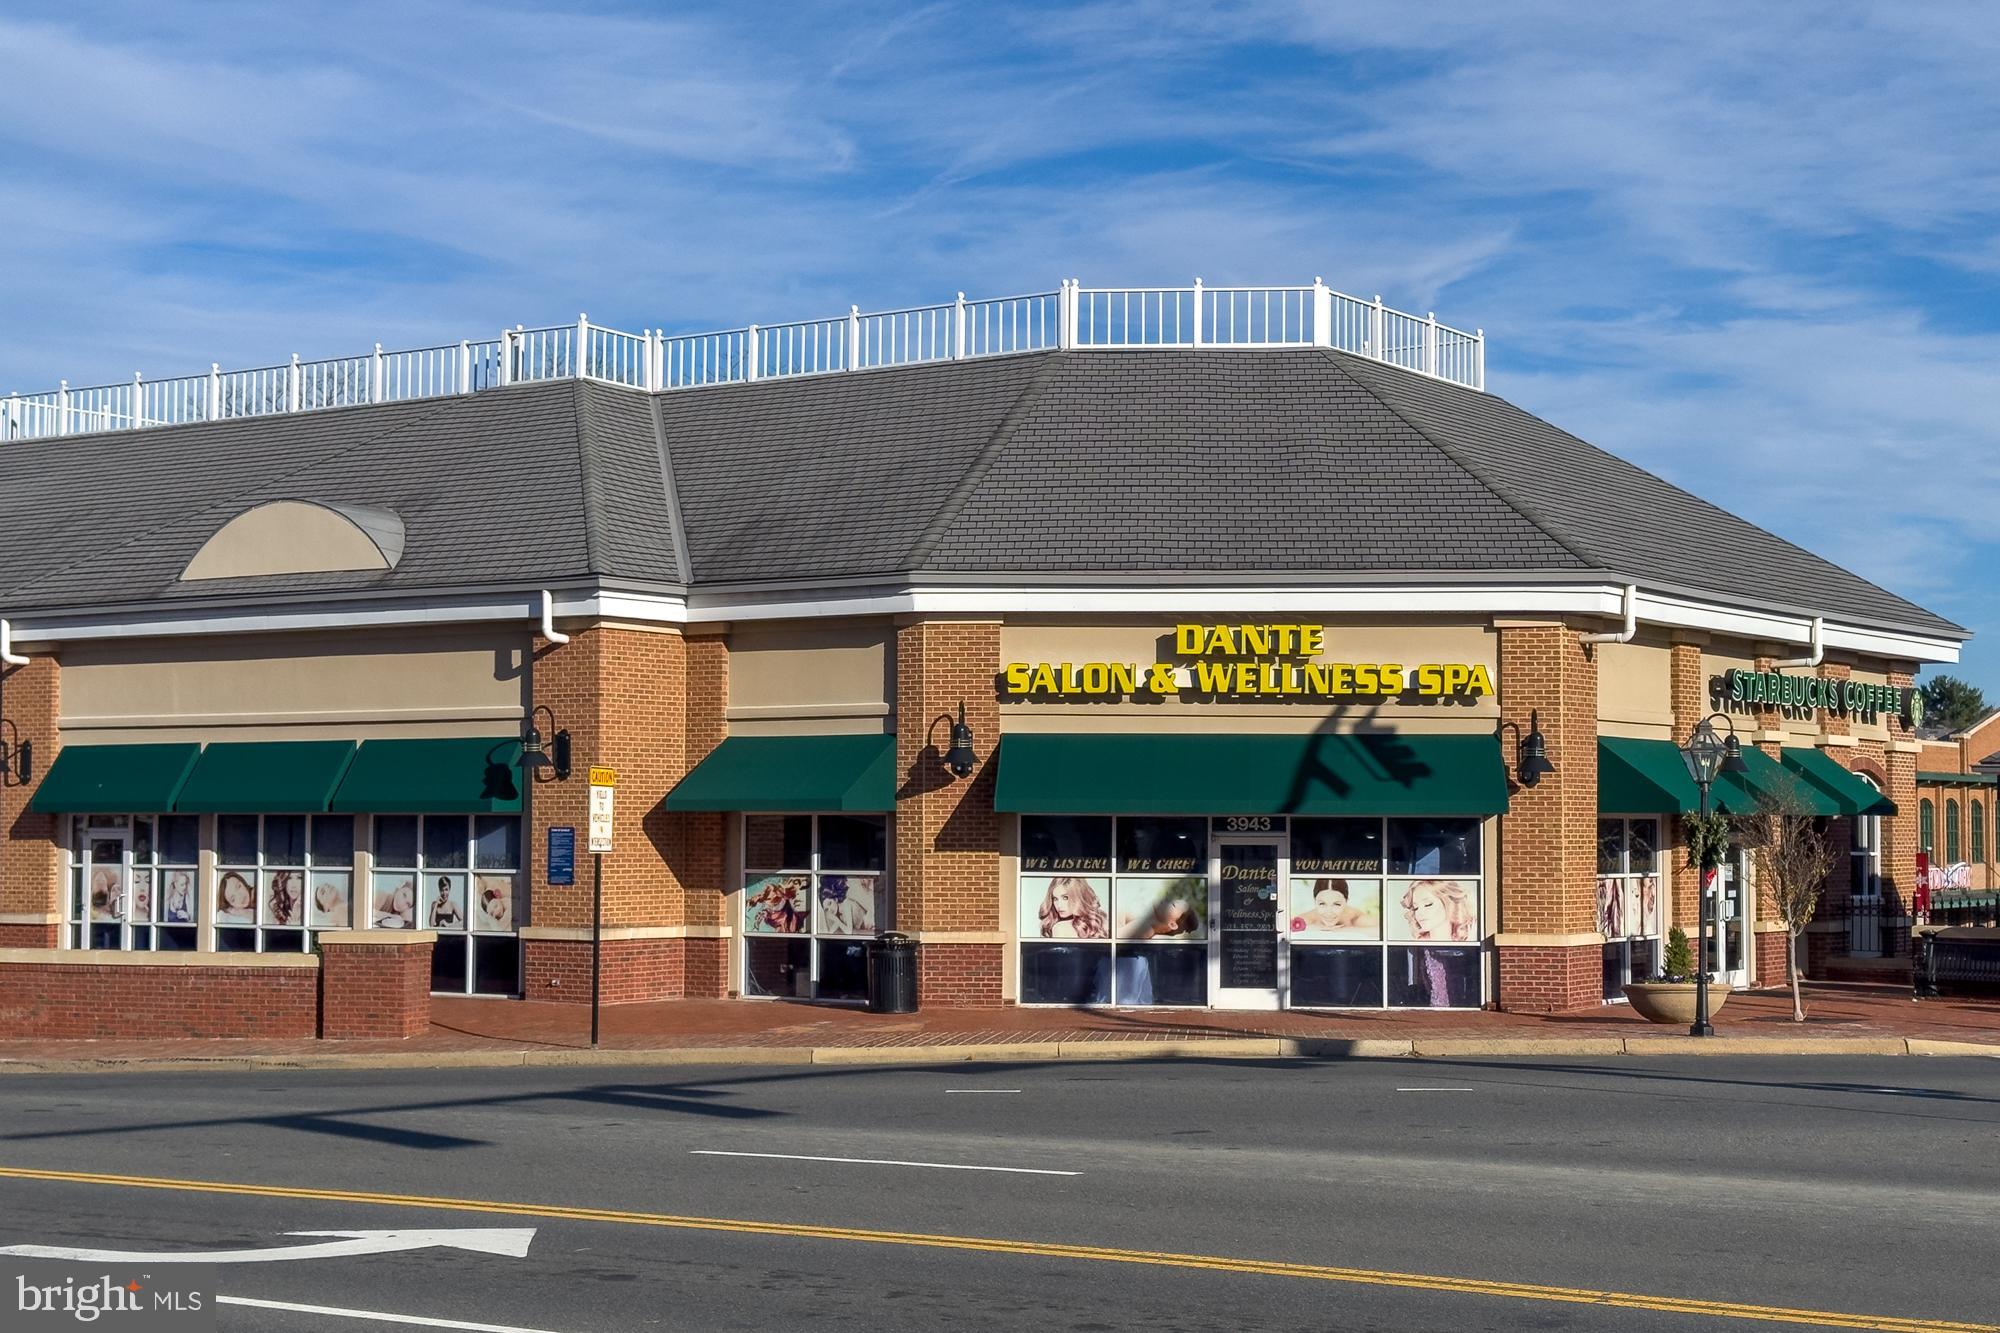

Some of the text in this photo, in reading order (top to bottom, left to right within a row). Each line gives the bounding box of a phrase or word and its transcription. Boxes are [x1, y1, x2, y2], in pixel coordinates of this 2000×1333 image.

[1176, 624, 1325, 655] DANTE
[1007, 662, 1495, 695] SALON & WELLNESS SPA
[1732, 668, 1901, 715] STARBUCKS COFFEE
[591, 770, 613, 783] CAUTION
[1226, 817, 1271, 831] 3943
[1025, 857, 1107, 869] WE LISTEN!
[1127, 857, 1196, 870] WE CARE!
[1295, 859, 1379, 871] YOU MATTER!
[1222, 865, 1277, 880] Dante
